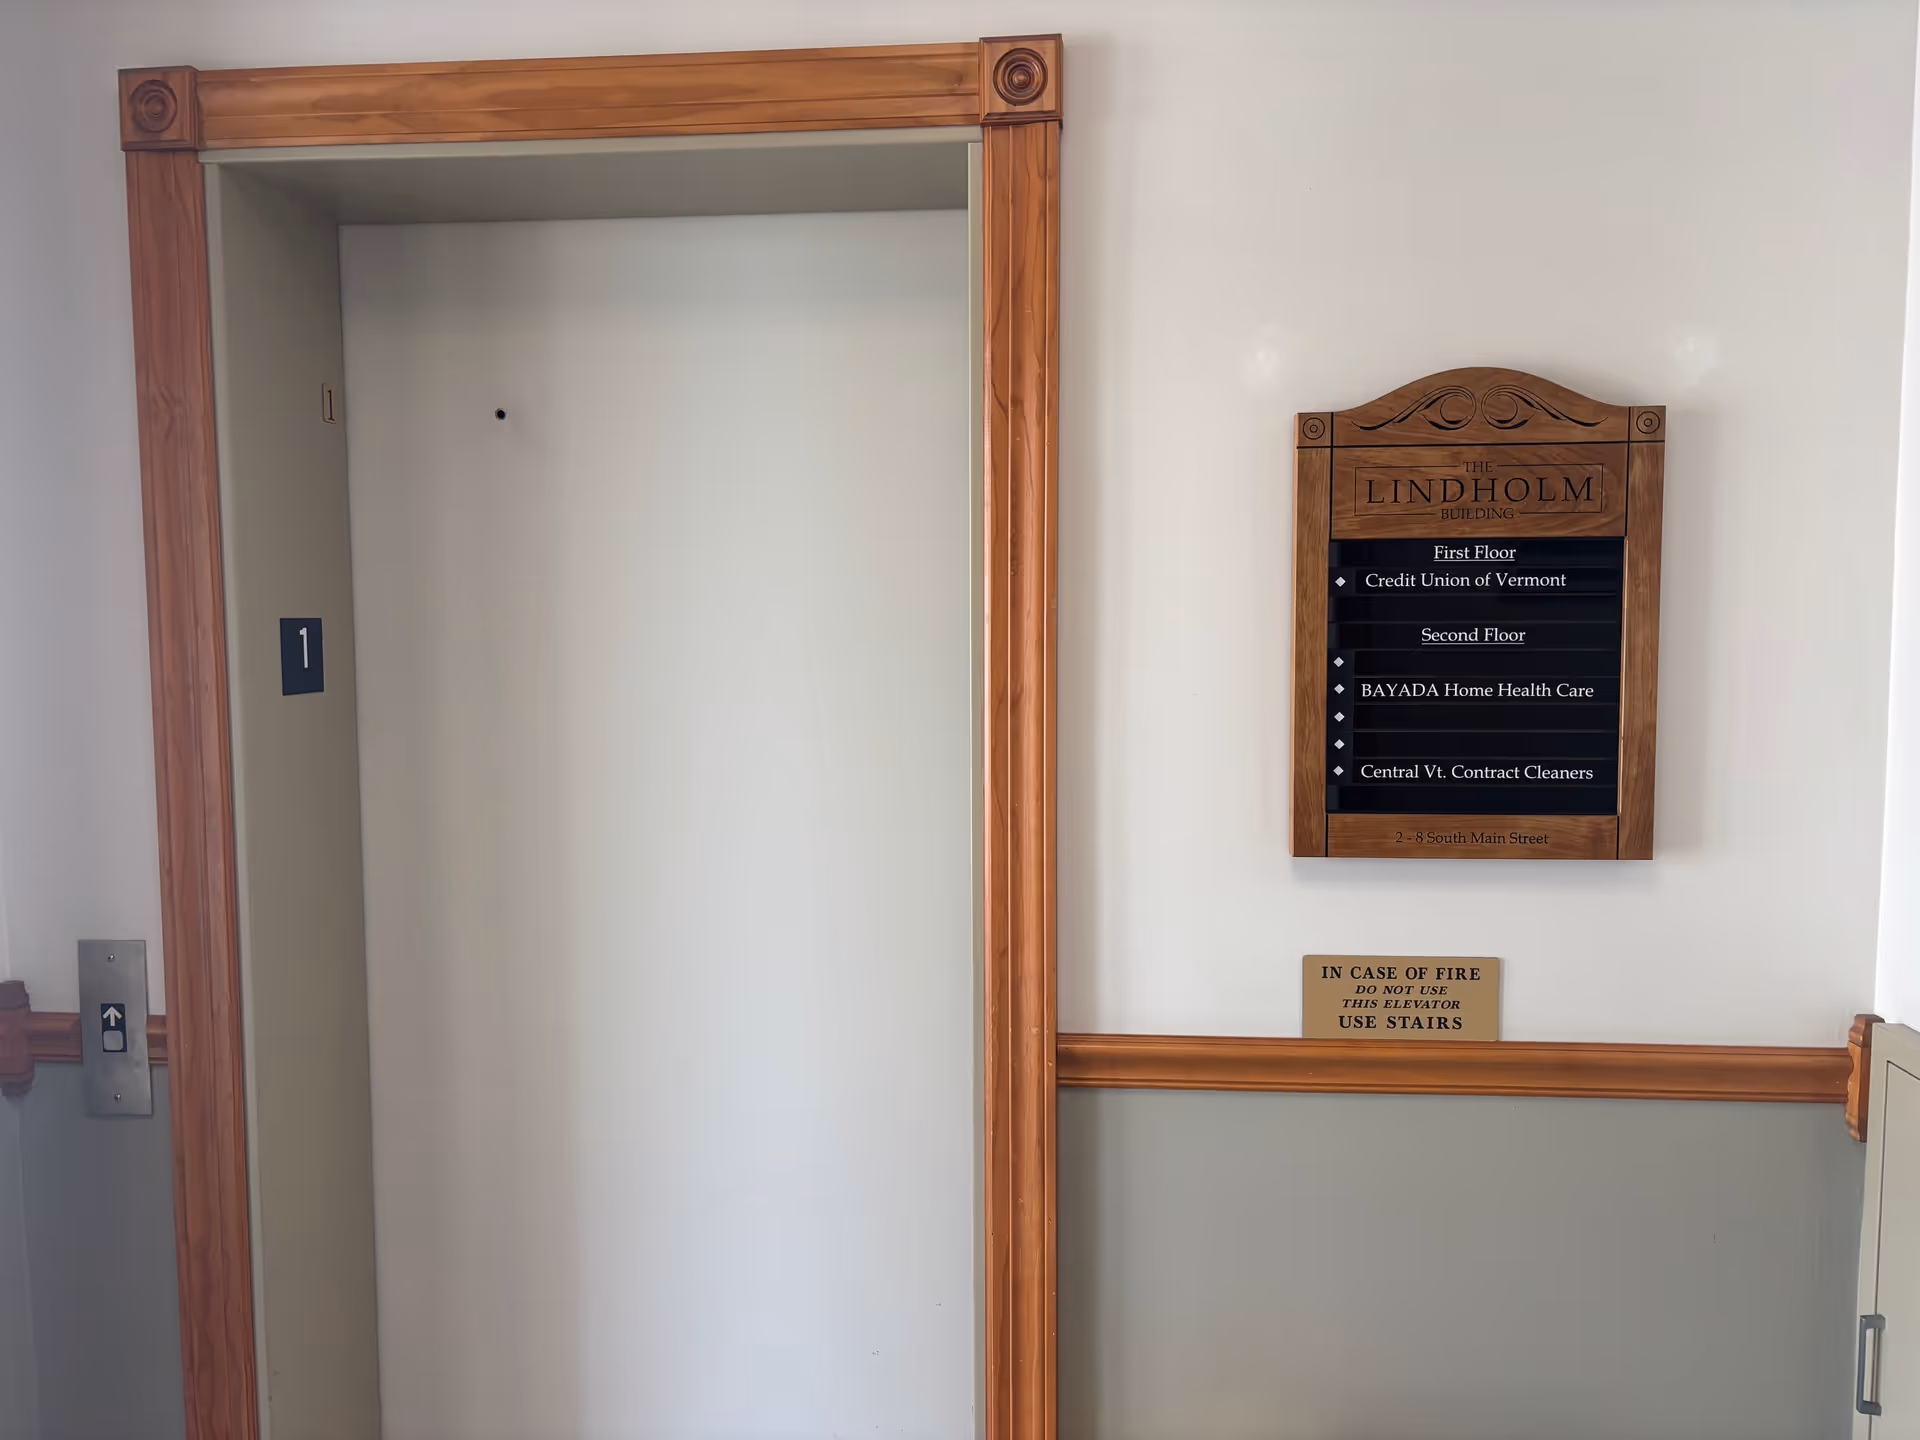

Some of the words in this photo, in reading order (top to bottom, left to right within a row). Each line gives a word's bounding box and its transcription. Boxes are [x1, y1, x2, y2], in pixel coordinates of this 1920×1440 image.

[327, 389, 335, 421] 1
[1463, 461, 1493, 473] THE
[1366, 477, 1594, 504] LINDHOLM
[1440, 508, 1514, 520] BUILDING
[1434, 545, 1470, 559] First
[1474, 545, 1516, 559] Floor
[1365, 572, 1416, 588] Credit
[1421, 573, 1470, 588] Union
[1474, 572, 1492, 587] of
[1496, 573, 1567, 587] Vermont
[1421, 628, 1479, 642] Second
[1484, 628, 1526, 642] Floor
[299, 627, 308, 668] 1
[1361, 683, 1439, 698] BAYADA
[1444, 683, 1493, 698] Home
[1498, 683, 1552, 698] Health
[1556, 684, 1594, 698] Care
[1361, 764, 1419, 779] Central
[1423, 765, 1446, 779] Vt.
[1451, 765, 1520, 780] Contract
[1524, 765, 1593, 780] Cleaners
[1395, 831, 1403, 843] 2
[1415, 832, 1423, 843] 8
[1427, 831, 1467, 844] South
[1470, 832, 1506, 844] Main
[1509, 832, 1549, 845] Street
[1322, 966, 1342, 979] IN
[1350, 966, 1398, 980] CASE
[1405, 967, 1427, 980] OF
[1436, 967, 1481, 980] FIRE
[1355, 985, 1377, 994] DO
[1383, 986, 1414, 995] NOT
[1420, 986, 1448, 995] USE
[1342, 999, 1378, 1008] THIS
[1383, 1000, 1461, 1009] ELEVATOR
[1339, 1016, 1377, 1029] USE
[1386, 1016, 1463, 1029] STAIRS
